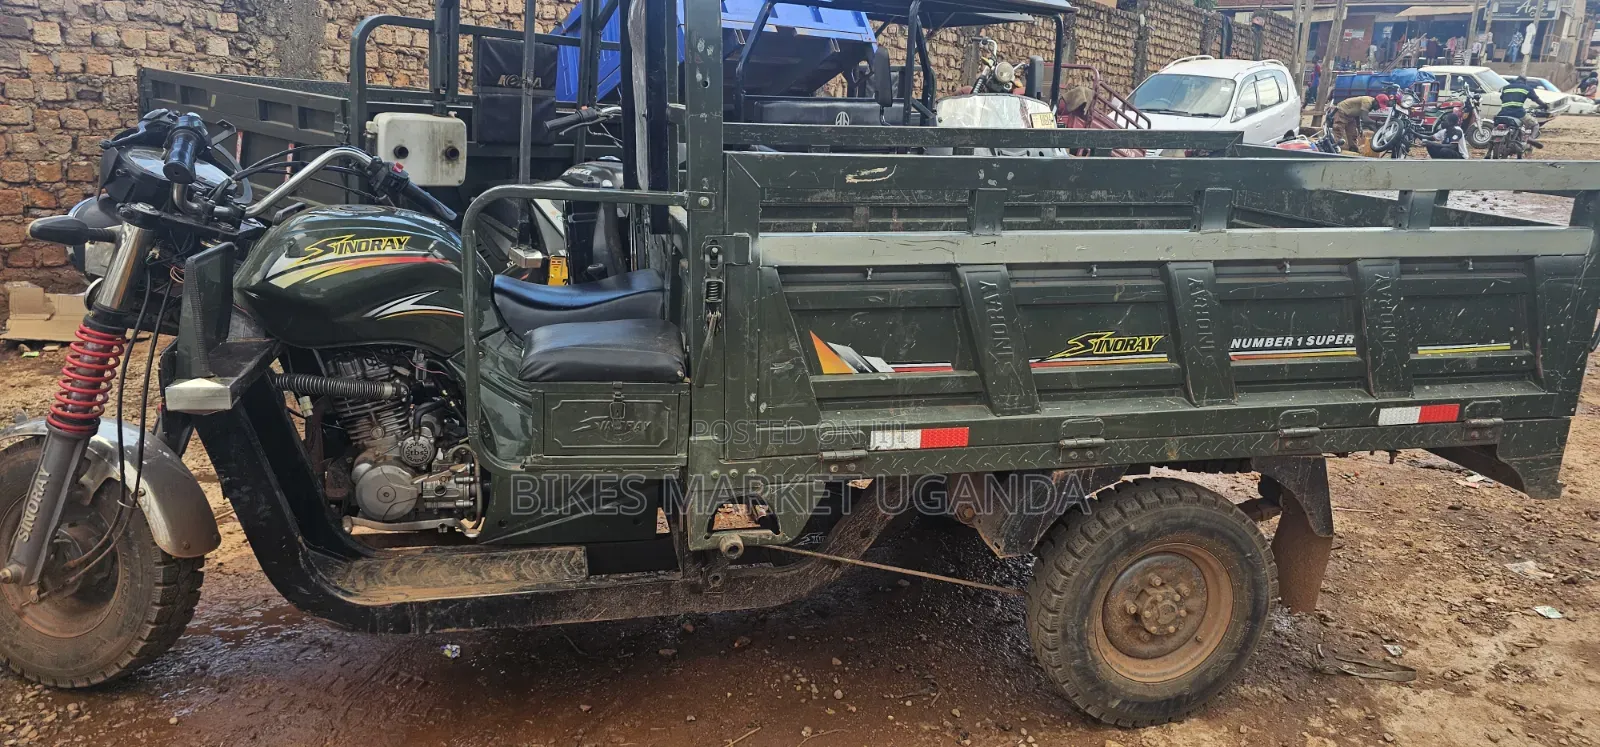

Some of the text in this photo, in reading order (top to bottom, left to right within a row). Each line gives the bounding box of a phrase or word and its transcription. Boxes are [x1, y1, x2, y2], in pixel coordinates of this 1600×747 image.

[296, 234, 411, 264] SINORAY
[1045, 331, 1164, 361] SINORAY
[1230, 334, 1355, 349] NUMBER 1 SUPER
[571, 415, 652, 433] SINRAY
[18, 466, 51, 543] SINORAY
